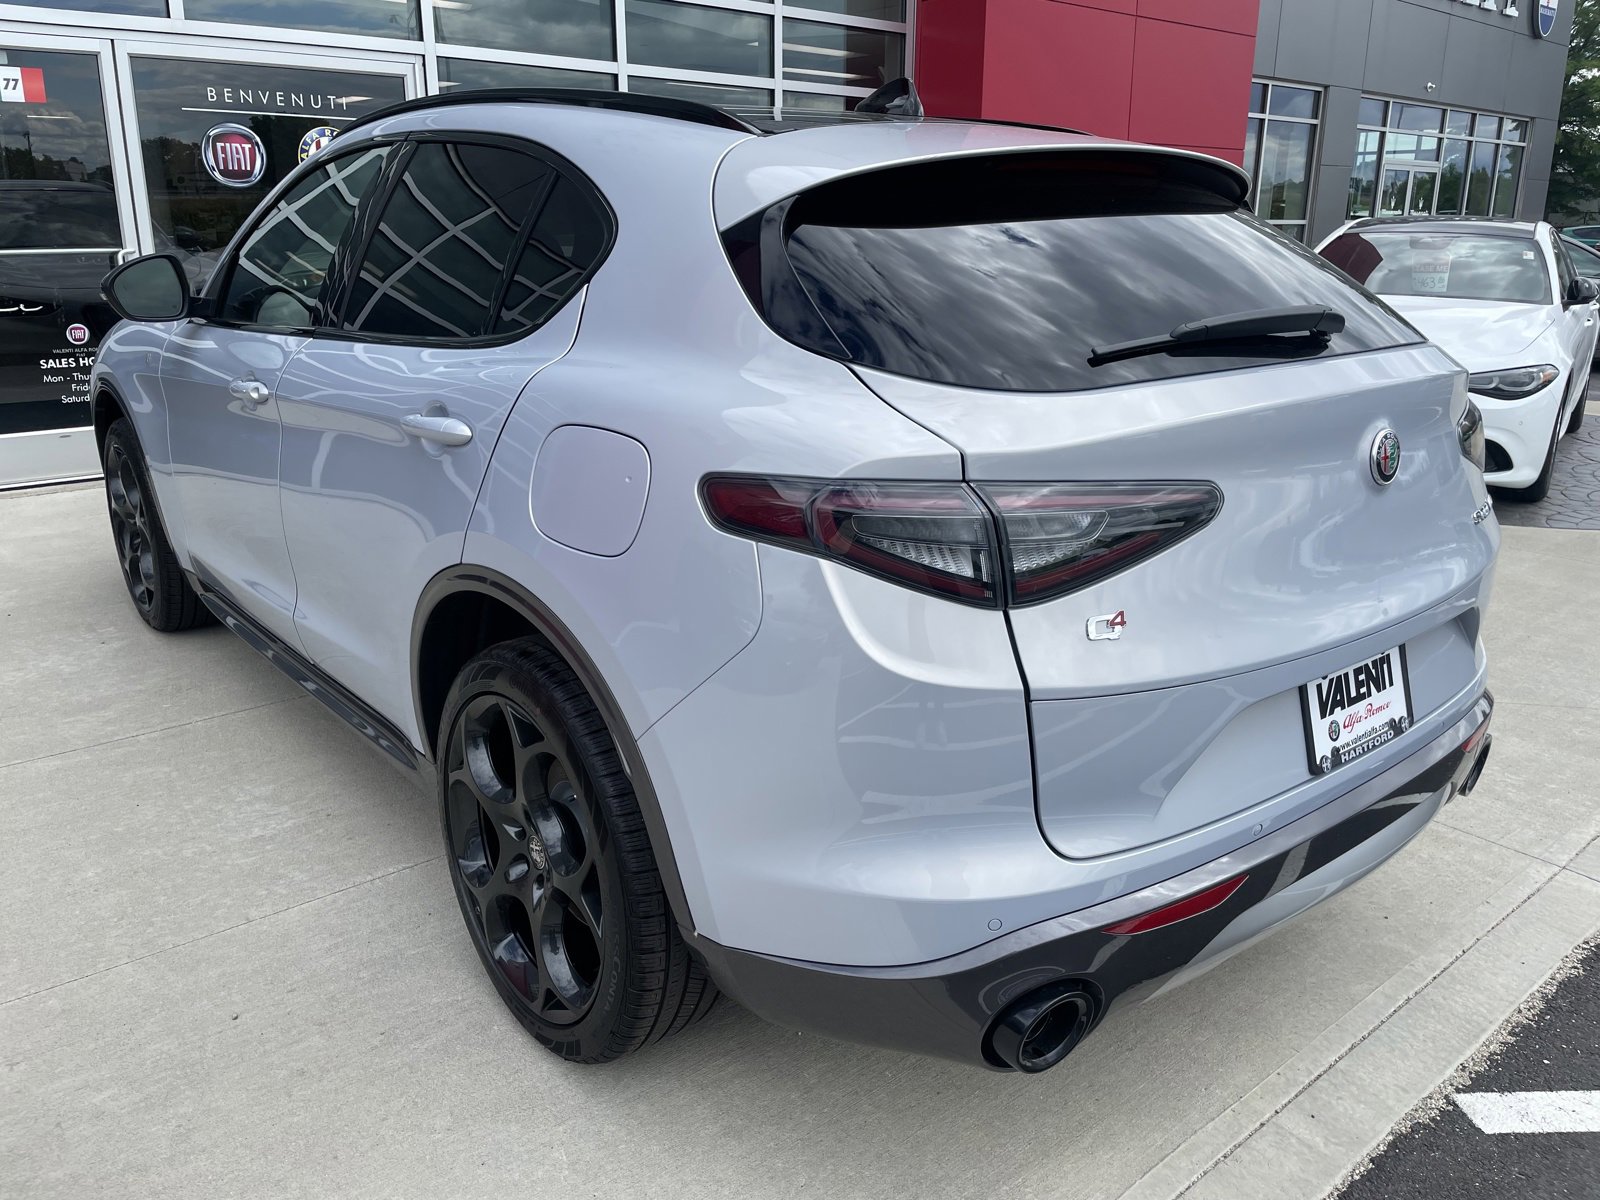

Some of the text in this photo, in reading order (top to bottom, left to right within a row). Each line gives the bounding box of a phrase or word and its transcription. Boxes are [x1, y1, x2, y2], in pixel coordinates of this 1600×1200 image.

[3, 78, 19, 90] 77
[206, 87, 347, 110] BENVENUTI
[216, 142, 252, 171] FIAT
[300, 132, 320, 160] ALFA
[71, 329, 85, 339] FIAT
[40, 358, 76, 369] SALES
[43, 375, 64, 383] Mon
[71, 383, 91, 392] Frid
[1316, 652, 1394, 720] VALENTI
[1343, 701, 1392, 733] Alfa Romeo
[1340, 730, 1395, 763] HARTFORD
